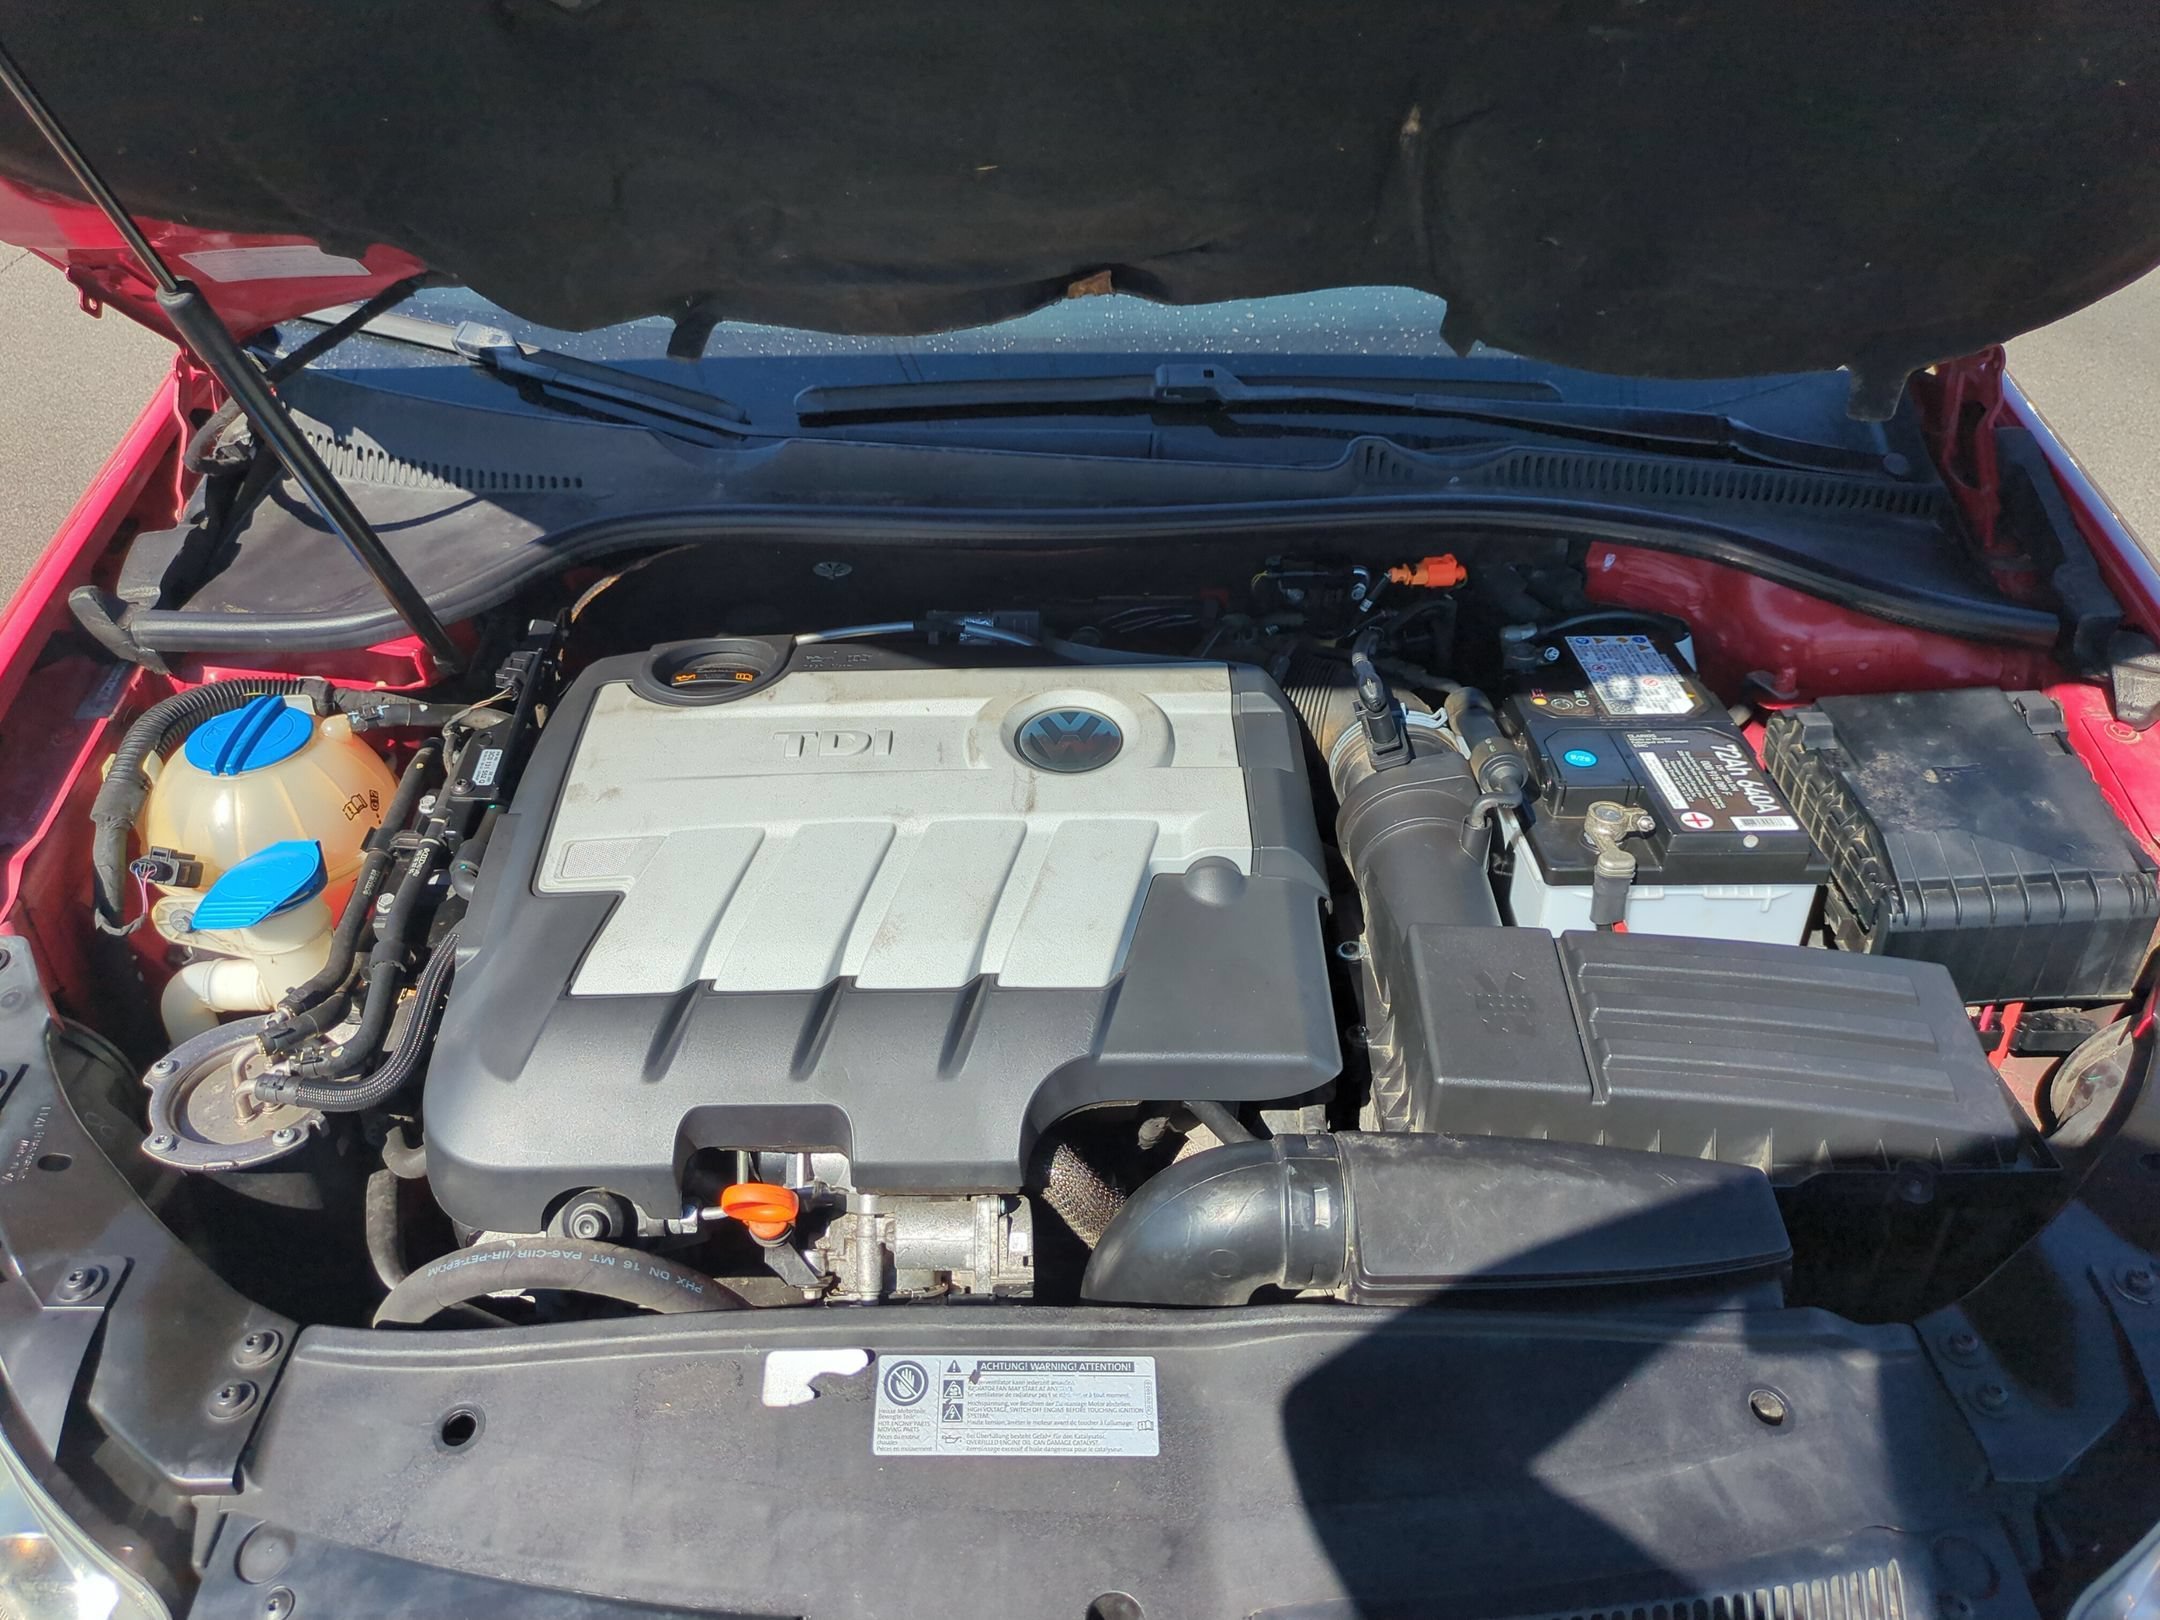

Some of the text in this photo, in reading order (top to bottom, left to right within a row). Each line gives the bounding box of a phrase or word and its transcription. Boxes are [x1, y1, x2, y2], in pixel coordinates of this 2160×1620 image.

[773, 728, 893, 757] TDI
[1710, 744, 1781, 814] 72Ah 640A
[590, 1254, 615, 1266] MT
[623, 1259, 640, 1272] 16
[648, 1266, 671, 1281] DN
[676, 1275, 704, 1294] PHX
[980, 1362, 1131, 1372] ACHTUNG! WARNING! ATTENTION!
